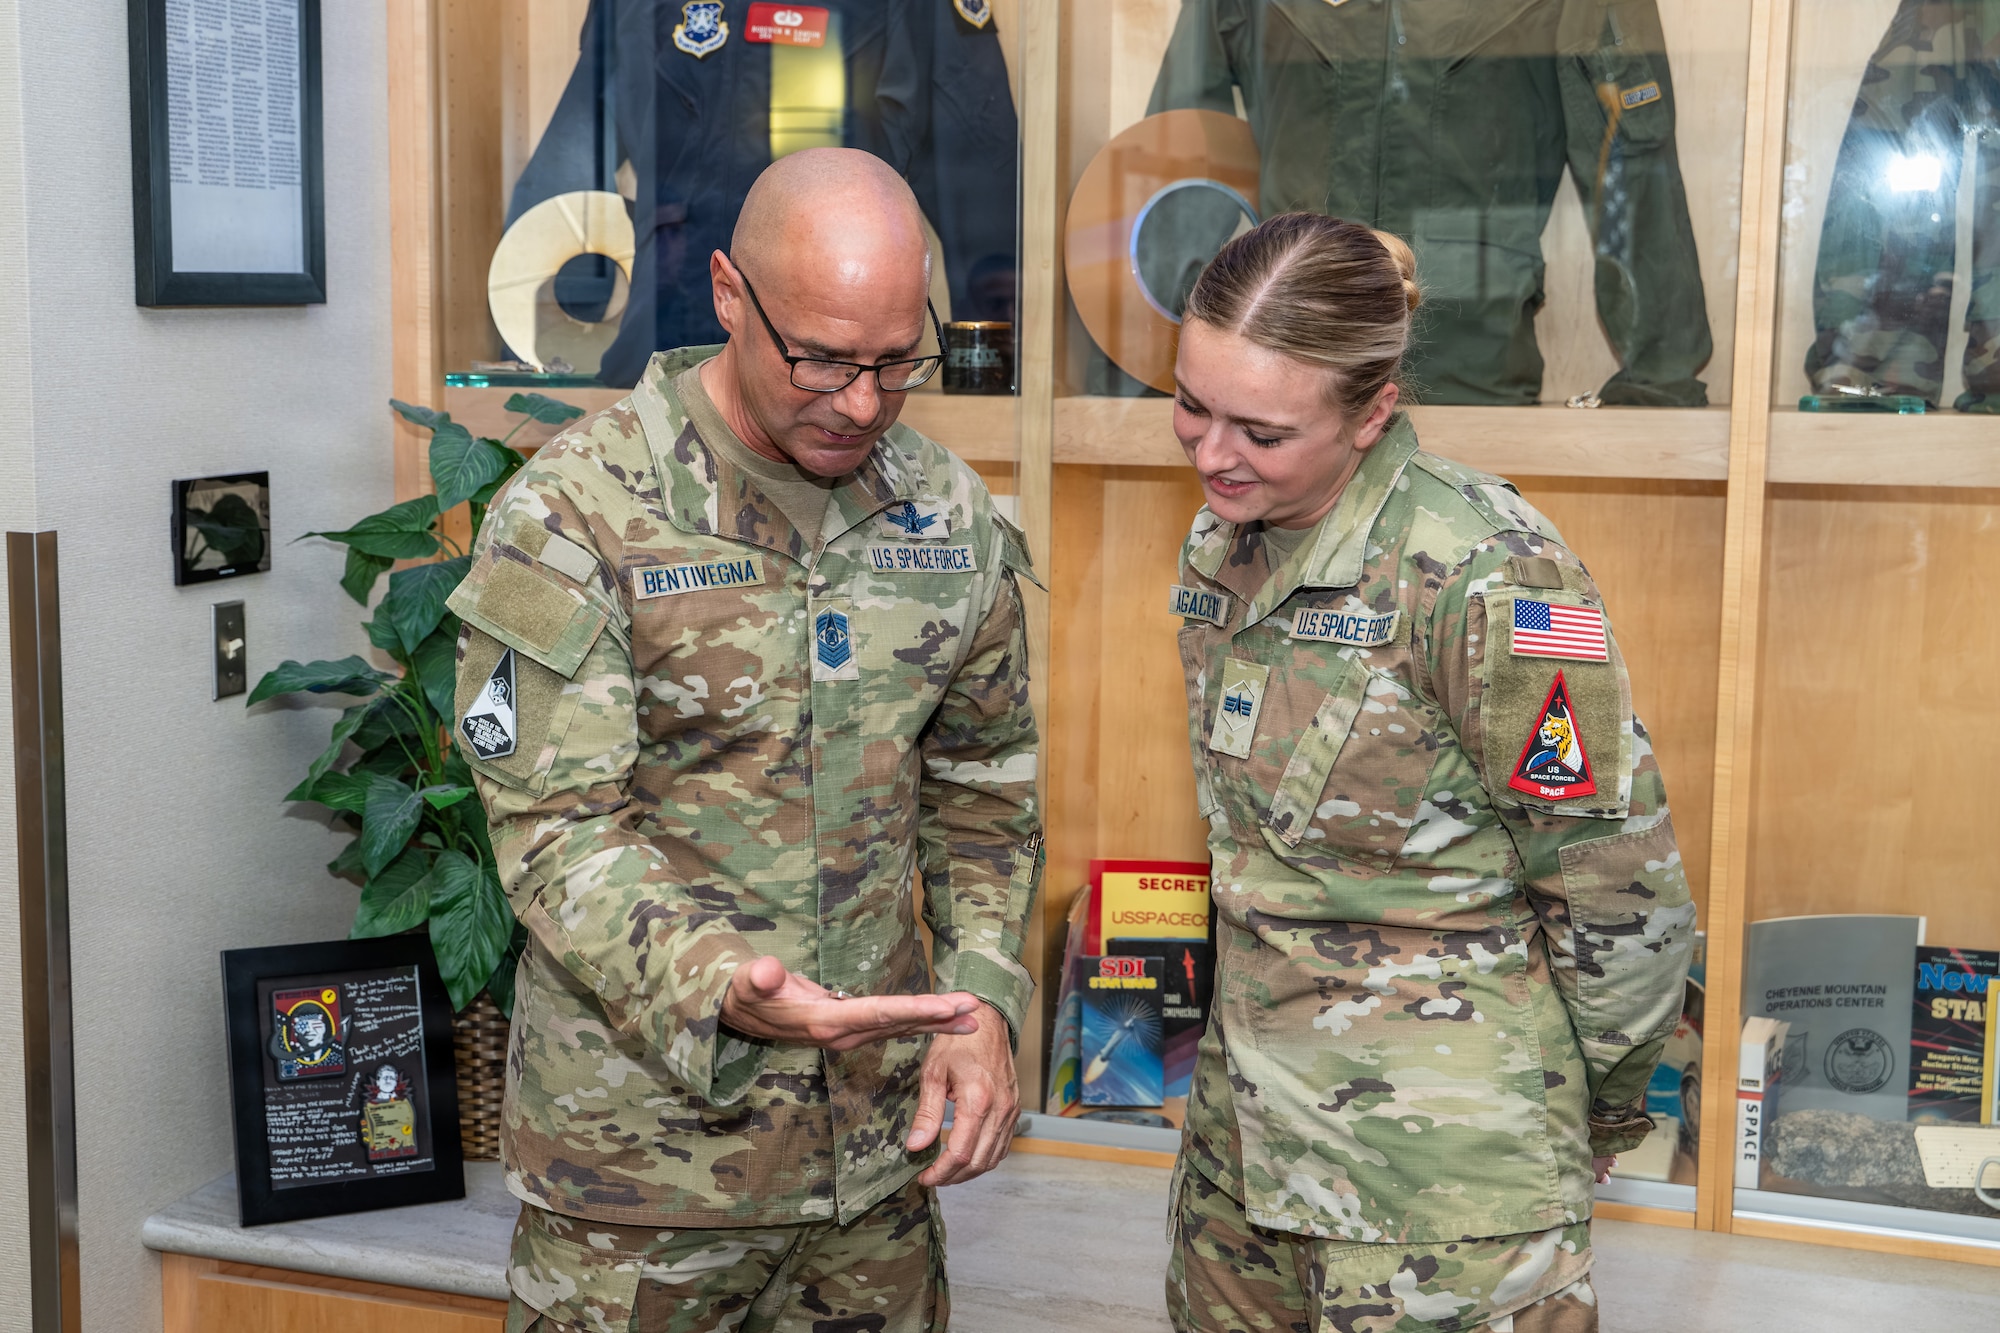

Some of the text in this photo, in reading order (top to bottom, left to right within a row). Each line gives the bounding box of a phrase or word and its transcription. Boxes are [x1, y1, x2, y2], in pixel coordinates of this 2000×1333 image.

[872, 548, 971, 569] U.S. SPACE FORCE
[642, 560, 758, 594] BENTIVEGNA
[1297, 612, 1394, 642] U.S. SPACE FORCE
[1547, 766, 1560, 774] US
[1540, 786, 1565, 796] SPACE
[1138, 878, 1208, 892] SECRET
[1099, 958, 1146, 977] SDI
[1089, 976, 1157, 989] STAR WARS
[1917, 962, 2000, 993] New
[1765, 984, 1887, 999] CHEYENNE MOUNTAIN
[1765, 997, 1885, 1013] OPERATIONS CENTER
[1931, 997, 1987, 1022] STA
[1921, 1060, 1951, 1069] Nuclear
[1927, 1052, 1979, 1063] Reagan's New
[1920, 1073, 1935, 1081] Will
[1744, 1104, 1759, 1161] SPACE
